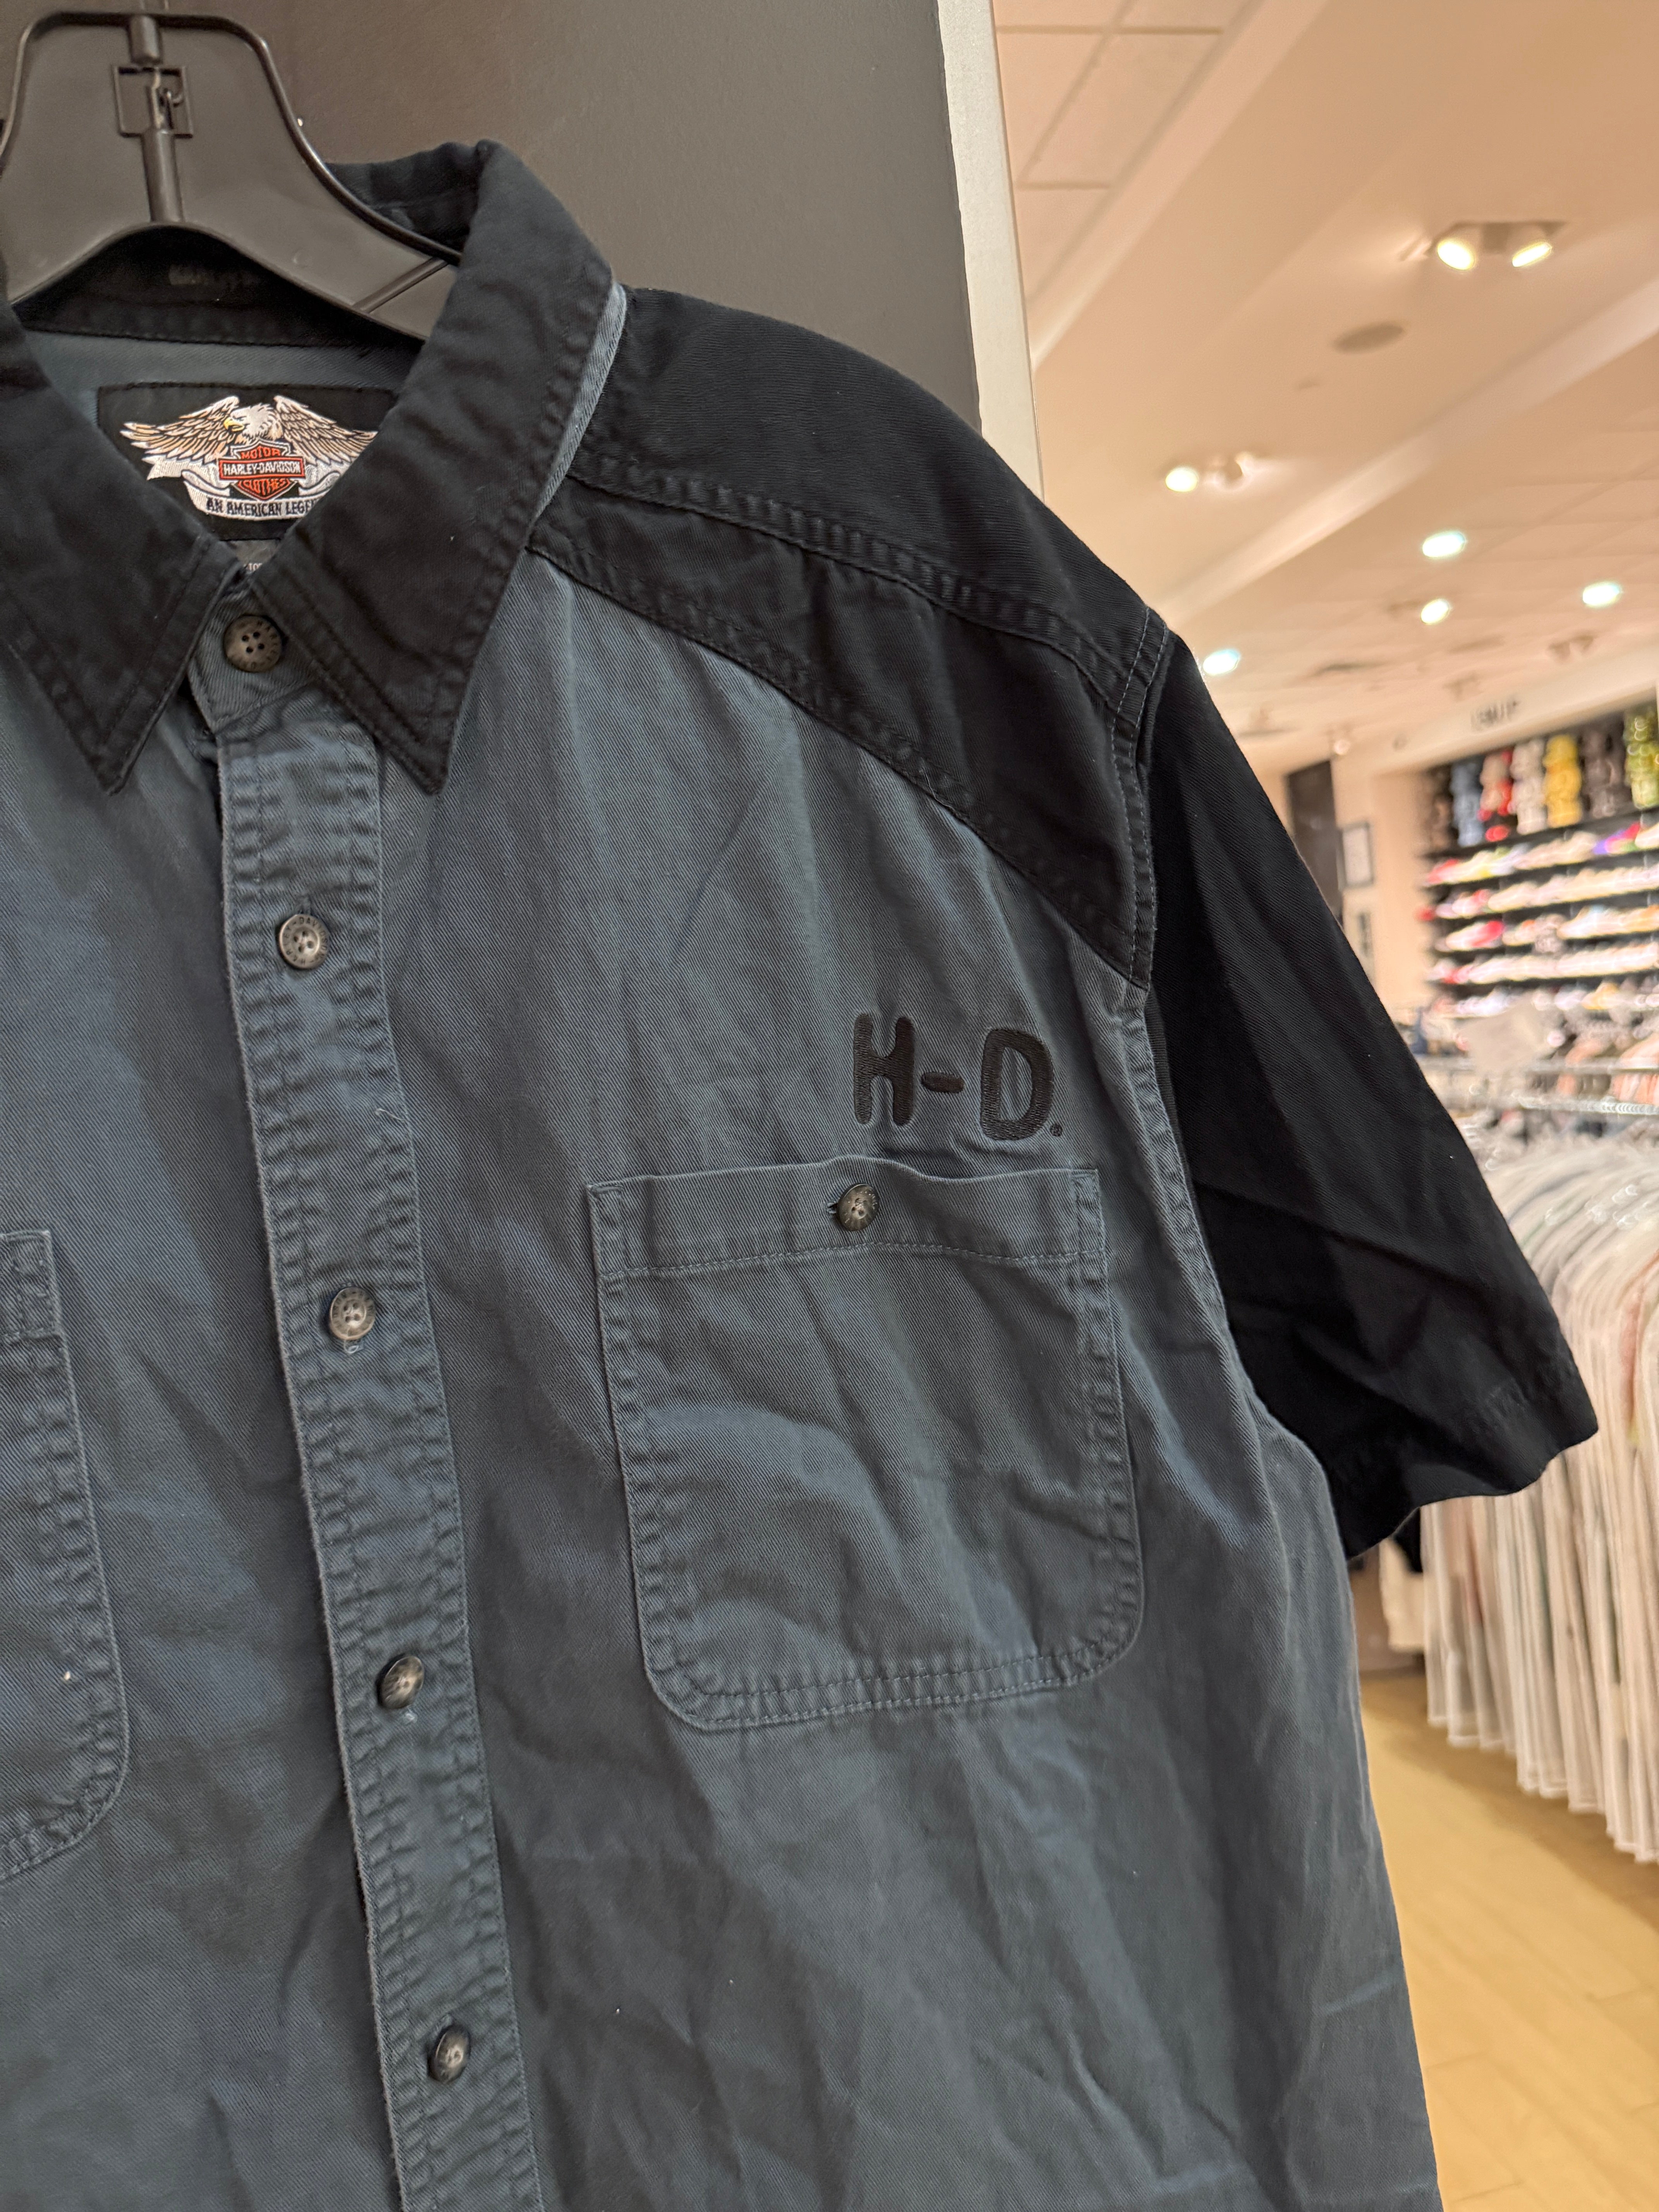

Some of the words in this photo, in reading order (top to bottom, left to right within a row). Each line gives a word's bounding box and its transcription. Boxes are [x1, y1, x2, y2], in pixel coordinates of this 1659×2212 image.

[241, 446, 280, 459] MOTOR
[223, 461, 301, 475] HARLEY-DAVIDSON
[243, 478, 286, 495] CLOTHES
[207, 497, 223, 513] AN
[227, 501, 282, 517] AMERICAN
[286, 499, 316, 514] LEGE
